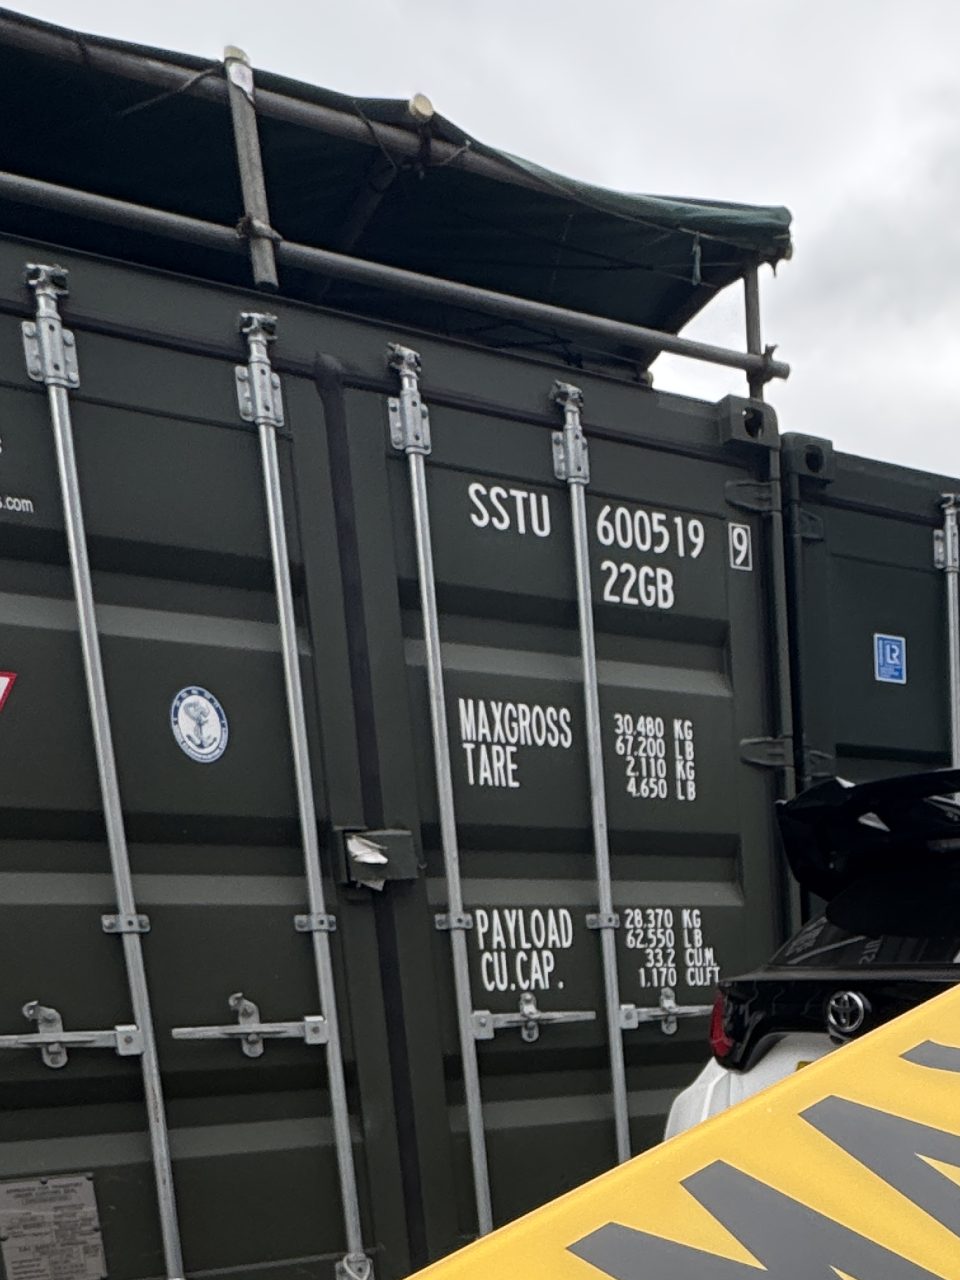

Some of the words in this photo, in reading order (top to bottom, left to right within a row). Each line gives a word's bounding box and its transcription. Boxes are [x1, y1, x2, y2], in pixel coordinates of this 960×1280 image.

[468, 482, 551, 538] SSTU
[596, 505, 705, 559] 600519
[731, 526, 750, 567] 9
[600, 560, 675, 610] 22GB
[458, 698, 573, 749] MAXGROSS
[614, 713, 665, 738] 30.480
[674, 718, 693, 740] KG
[462, 743, 520, 788] TARE
[626, 756, 667, 778] 2.110
[676, 760, 695, 780] KG
[615, 735, 666, 758] 67.200
[675, 740, 694, 761] LB
[627, 777, 668, 799] 4.650
[677, 781, 696, 801] LB
[475, 908, 573, 950] PAYLOAD
[624, 908, 673, 929] 28.370
[681, 908, 701, 929] KG
[625, 929, 675, 949] 62.550
[683, 930, 703, 949] LB
[644, 948, 676, 968] 33.2
